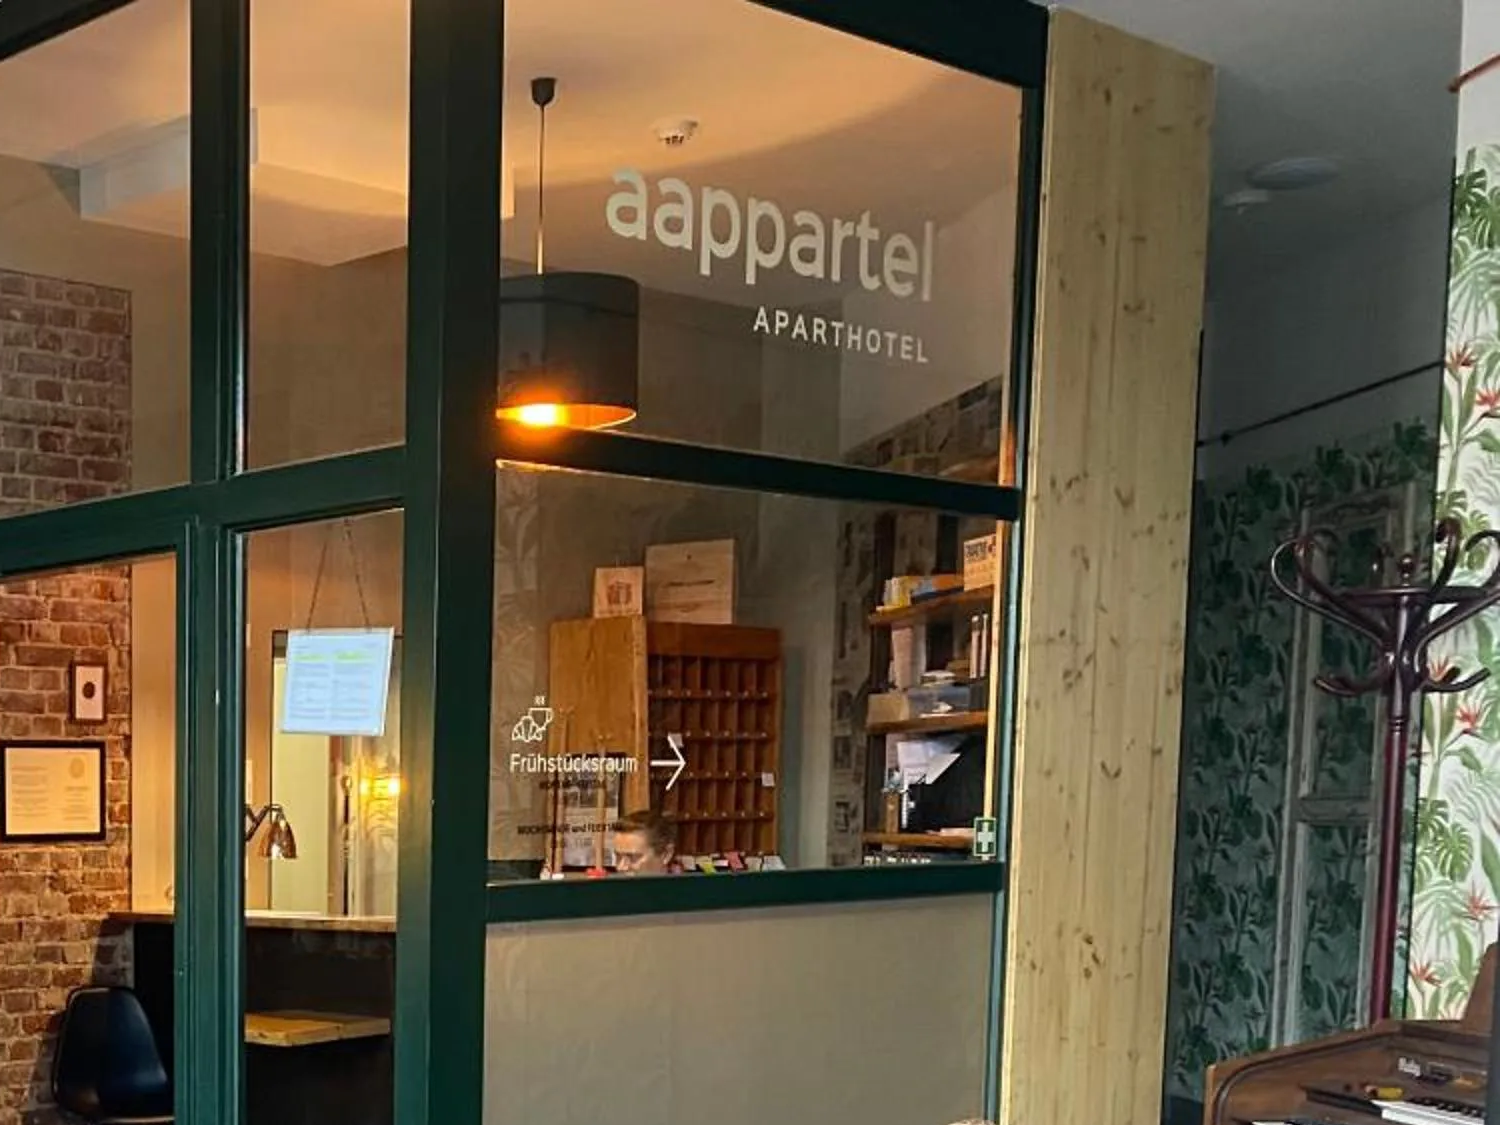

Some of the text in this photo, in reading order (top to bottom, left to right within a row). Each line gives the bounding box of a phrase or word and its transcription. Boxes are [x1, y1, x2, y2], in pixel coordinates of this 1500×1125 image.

[605, 168, 933, 302] aappartel
[753, 306, 929, 364] APARTHOTEL
[509, 752, 638, 773] Frühstücksraum
